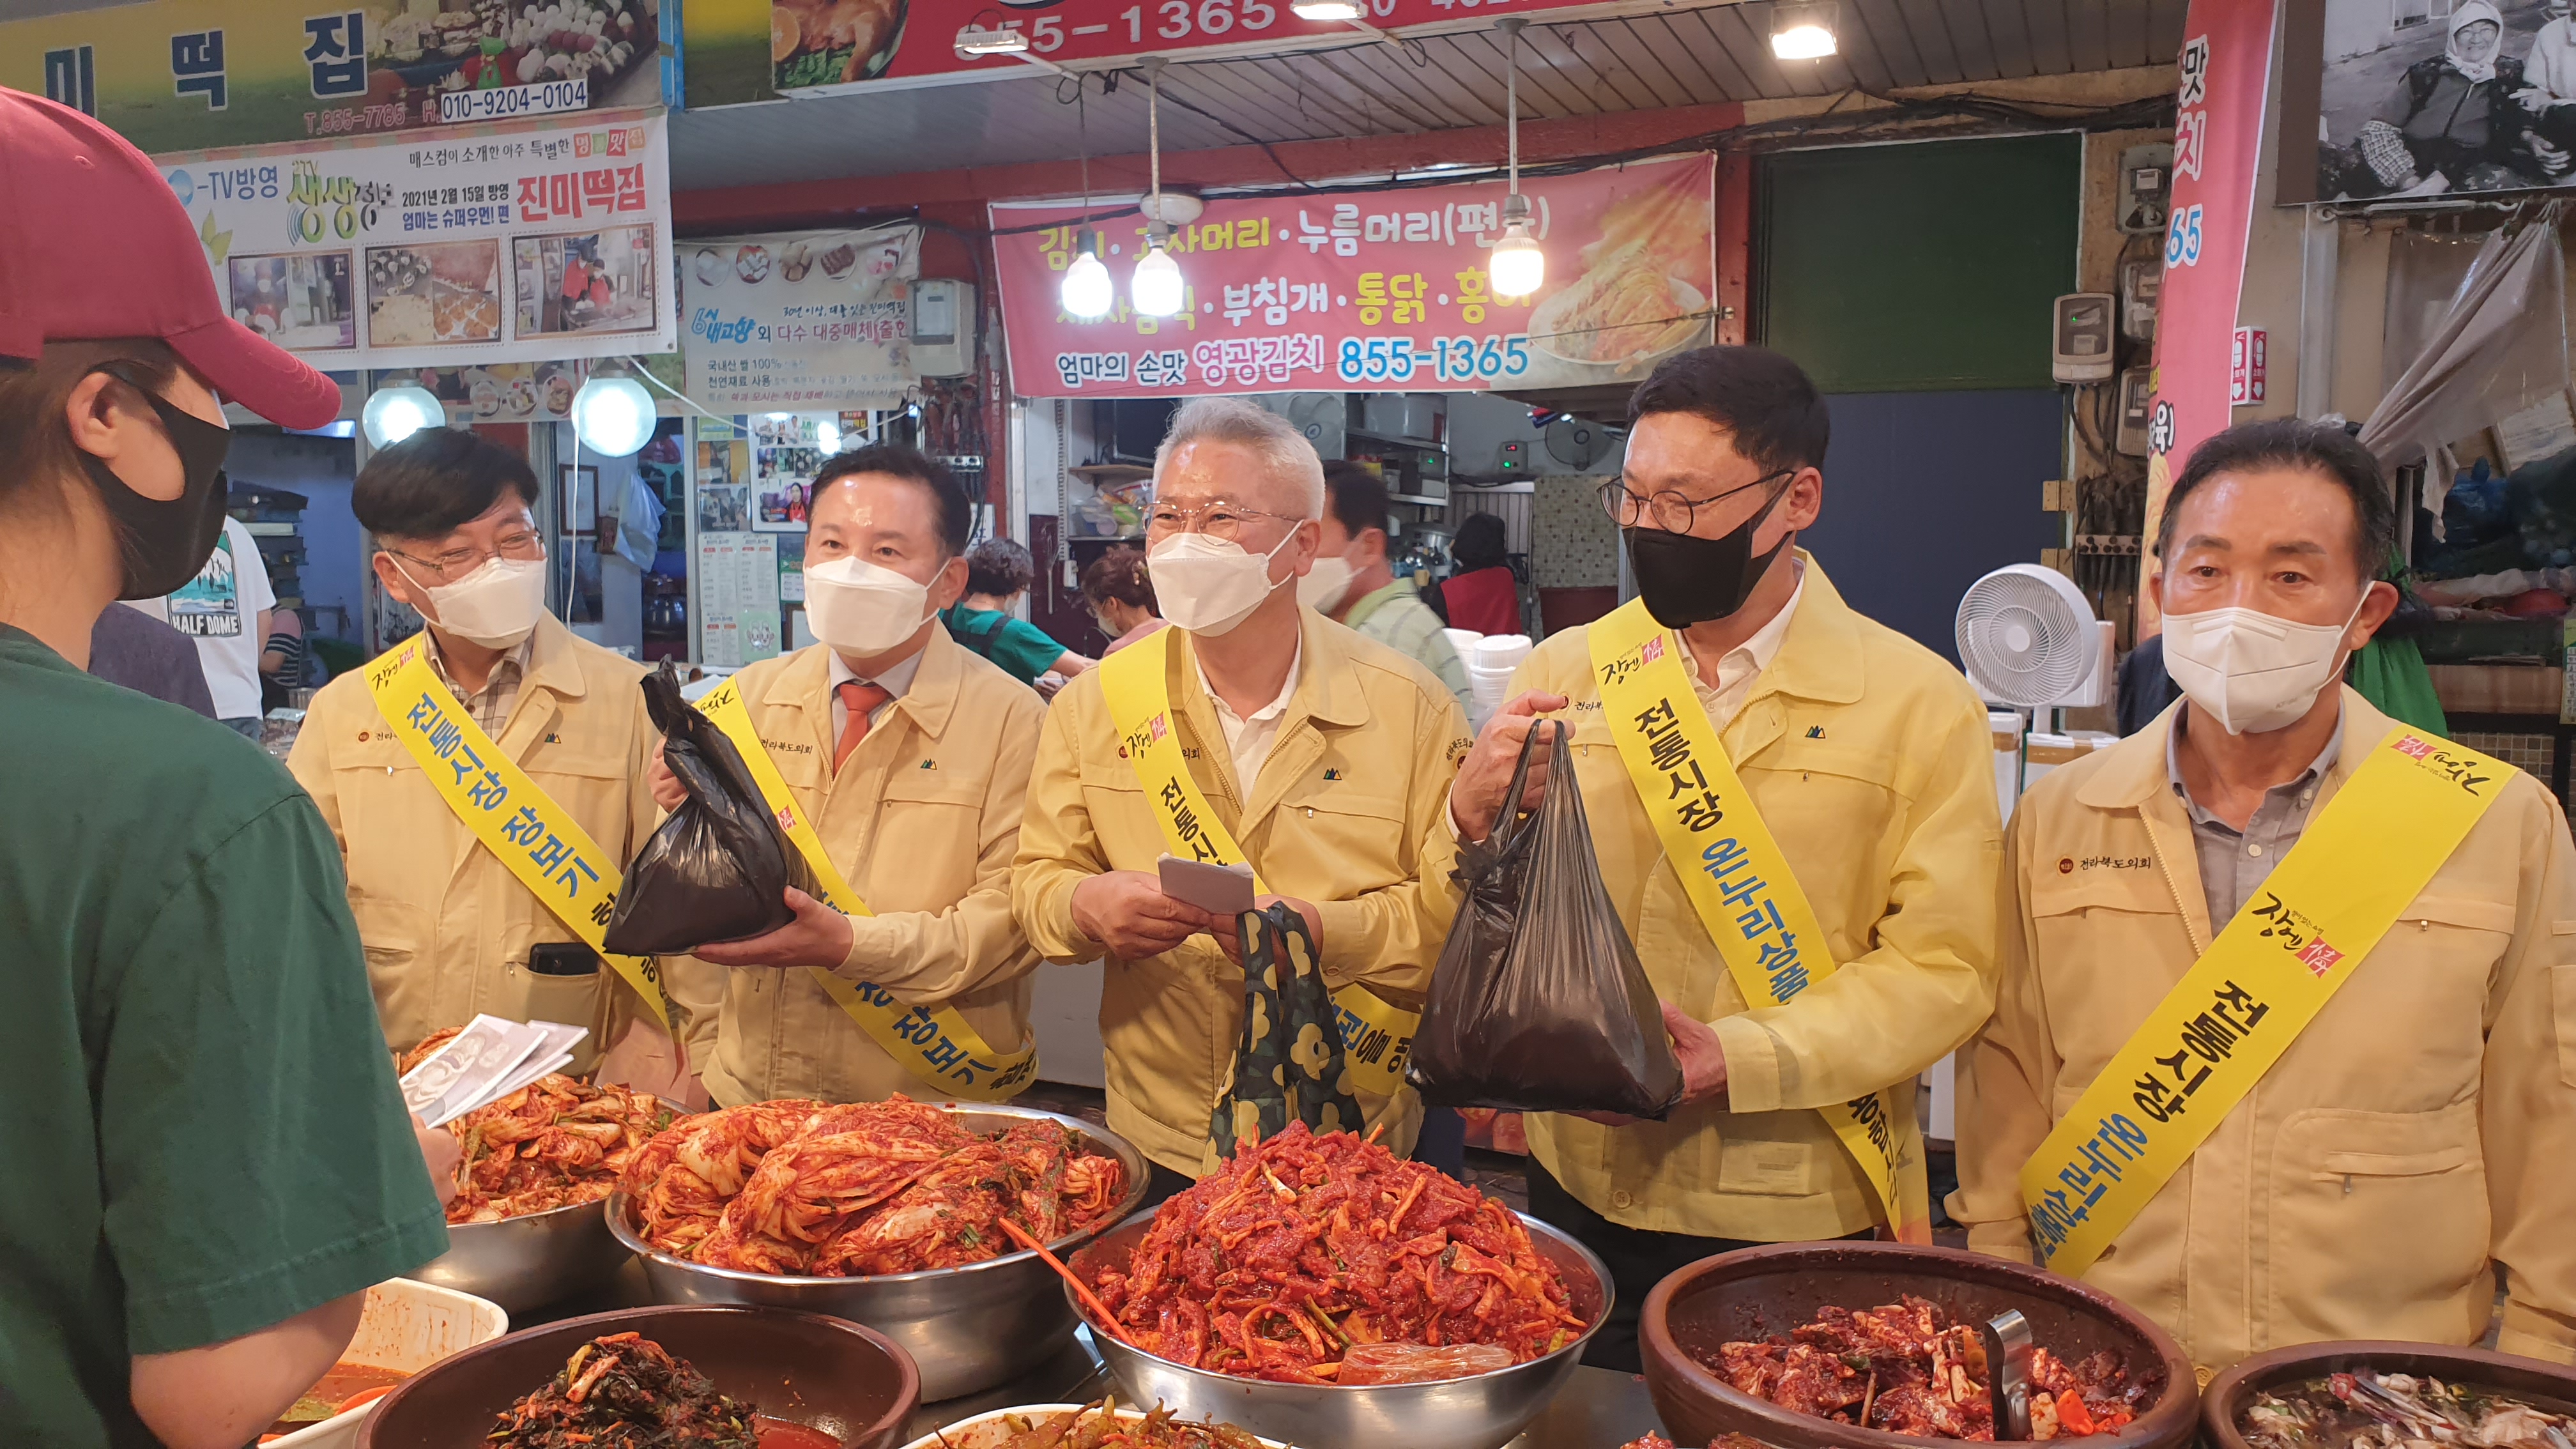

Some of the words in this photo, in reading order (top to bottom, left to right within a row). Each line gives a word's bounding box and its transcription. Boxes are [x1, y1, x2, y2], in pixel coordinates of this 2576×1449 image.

[410, 148, 459, 169] 매스컴이
[462, 144, 500, 163] 소개한
[502, 142, 525, 158] 아주
[530, 139, 571, 161] 특별한
[402, 190, 438, 208] 2021년
[441, 188, 458, 205] 2월
[462, 185, 485, 203] 15일
[487, 183, 510, 202] 방영
[402, 210, 439, 232] 엄마는
[442, 206, 495, 229] 슈퍼우먼!
[498, 204, 510, 224] 편
[516, 162, 647, 224] 진미떡집
[1223, 277, 1328, 326] 부침개
[1354, 272, 1429, 326] 통닭
[705, 316, 756, 344] 내고향
[758, 325, 772, 344] 외
[777, 325, 808, 342] 다수
[812, 320, 873, 342] 대중매체
[751, 358, 782, 371] 100%
[1057, 353, 1129, 387] 엄마의
[1135, 349, 1188, 387] 손맛
[1193, 334, 1324, 387] 영광김치
[1338, 334, 1531, 383] 855-1365
[171, 614, 205, 635] HALF
[206, 614, 238, 635] DOME
[1633, 697, 1724, 833] 전통시장
[407, 691, 509, 811] 전통시장
[500, 805, 599, 898] 장보기
[1160, 775, 1229, 866] 전통시
[893, 1006, 998, 1085] 장보기
[2133, 979, 2270, 1123] 전통시장
